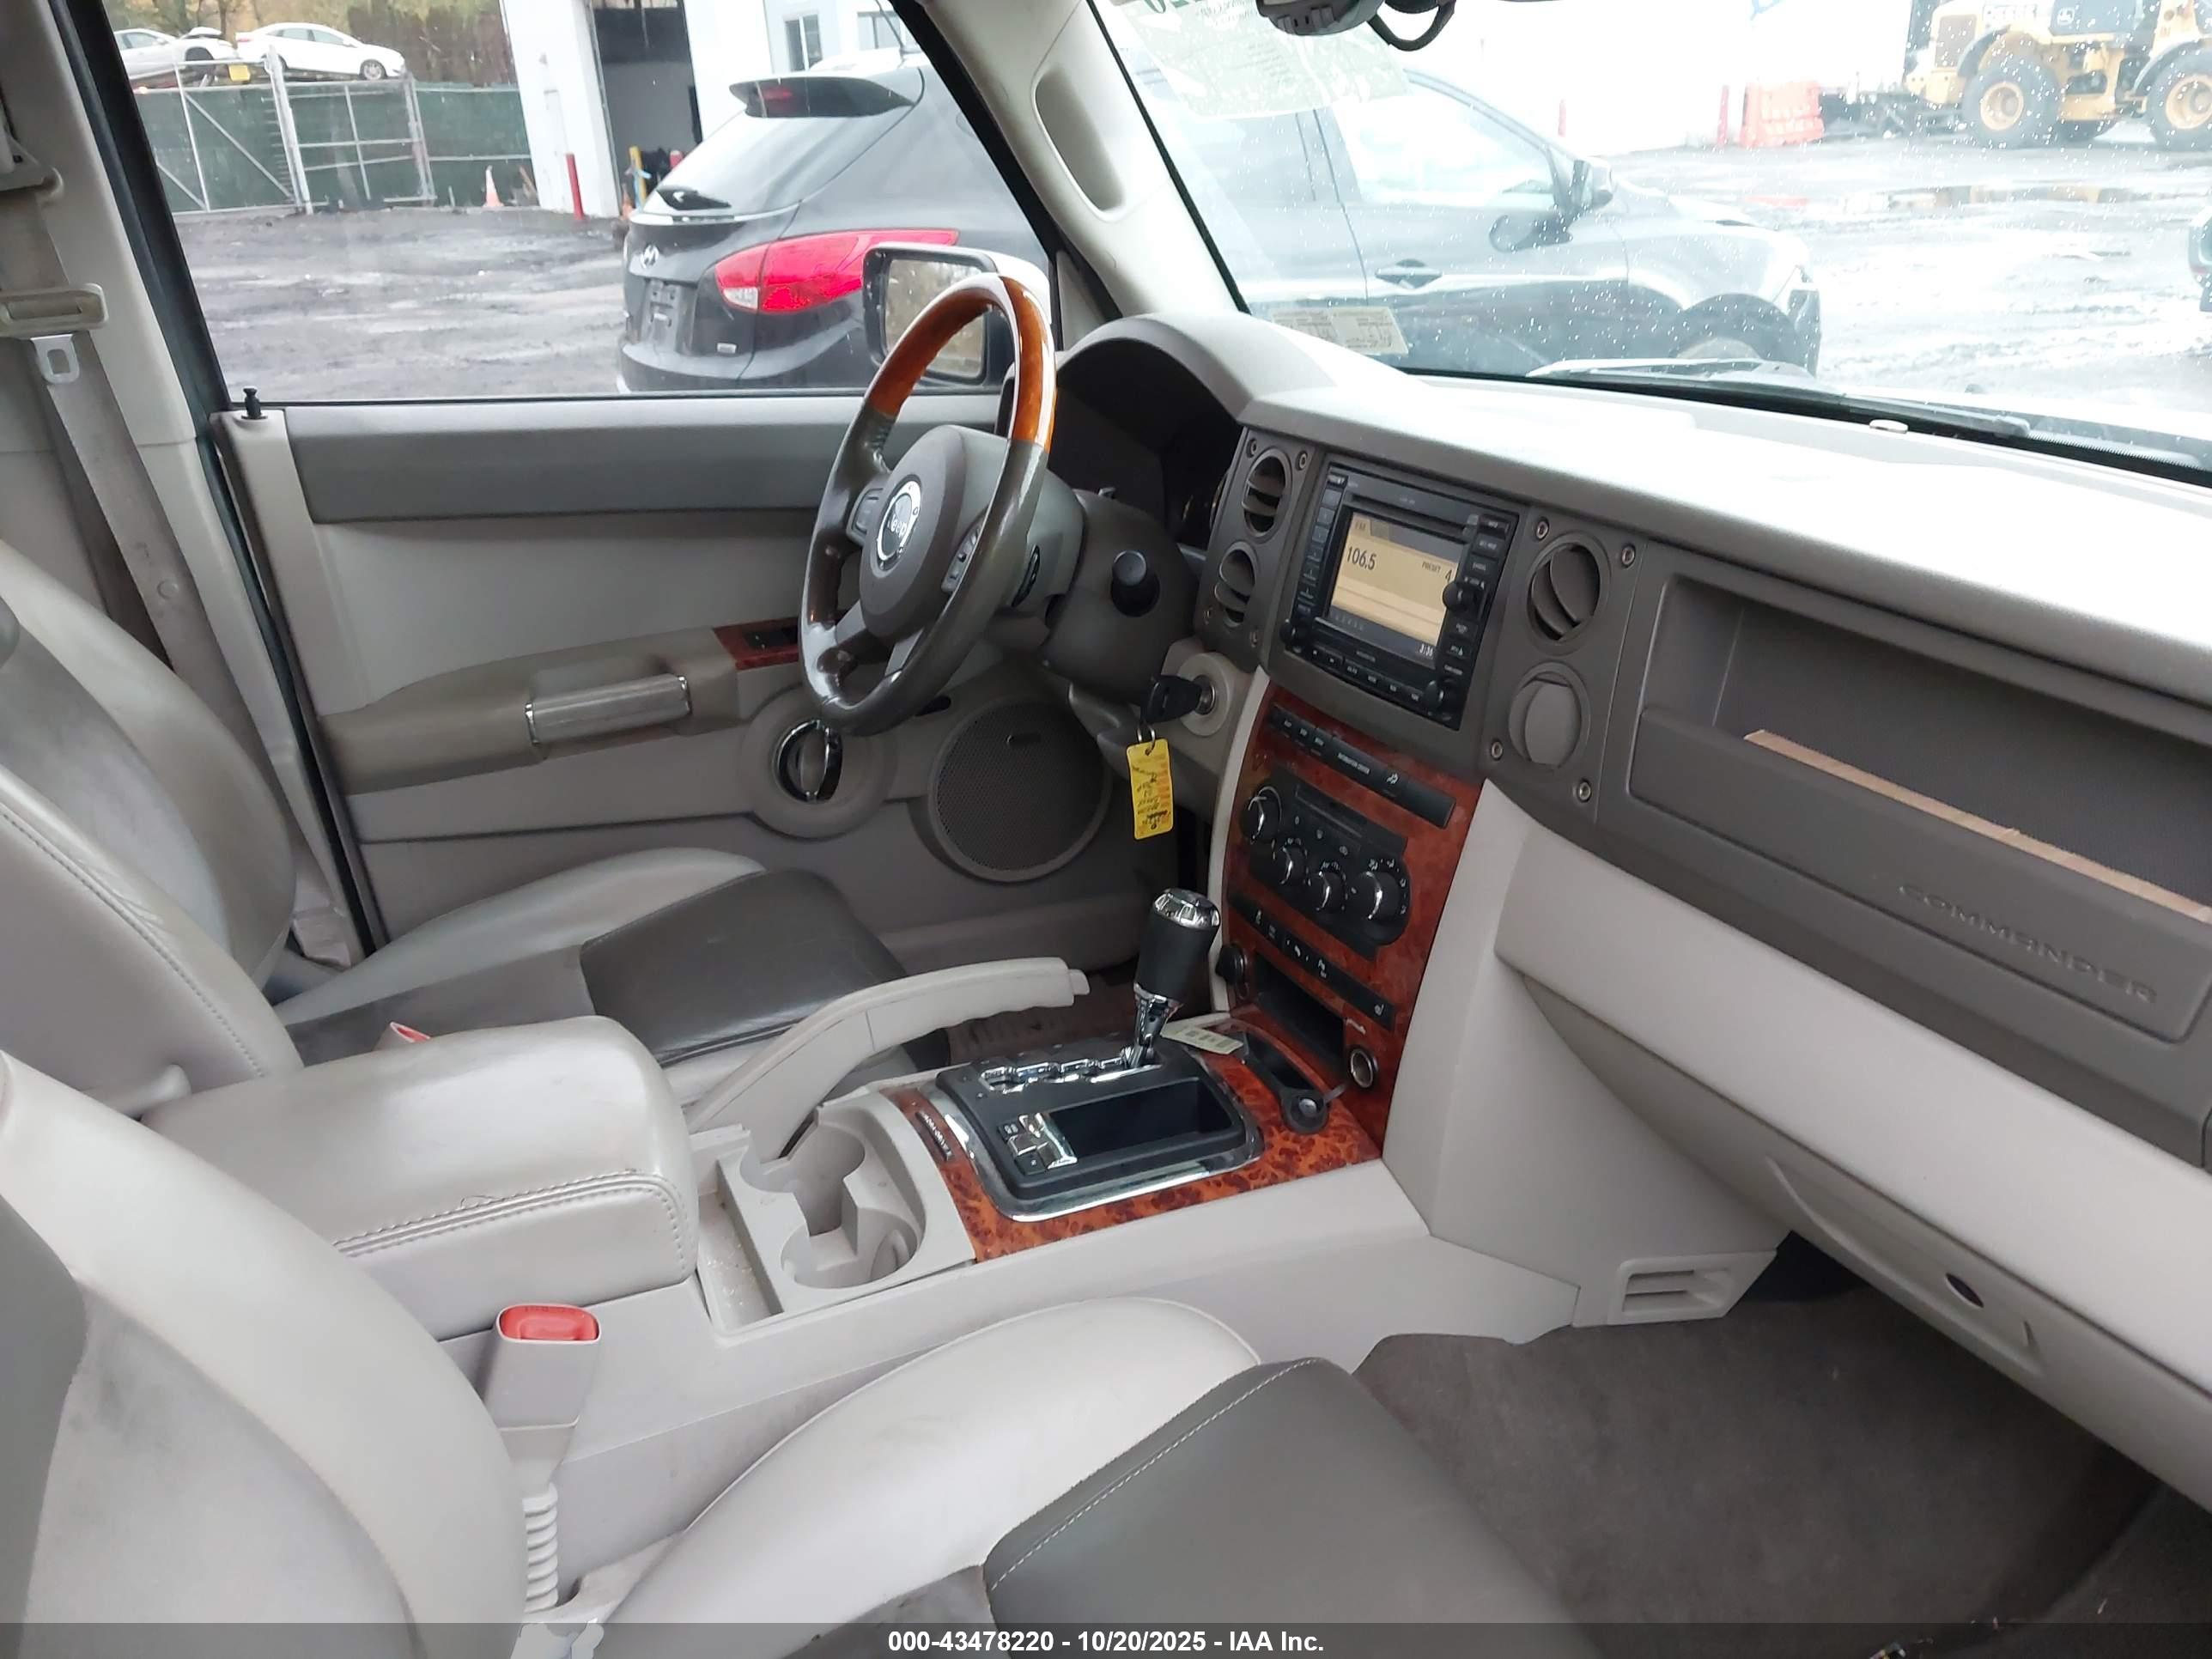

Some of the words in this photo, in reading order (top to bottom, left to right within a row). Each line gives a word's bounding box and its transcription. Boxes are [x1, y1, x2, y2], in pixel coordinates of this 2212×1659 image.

[887, 513, 908, 538] Jeep
[1347, 546, 1376, 570] 106.5
[1896, 884, 2158, 1004] COMMANDER
